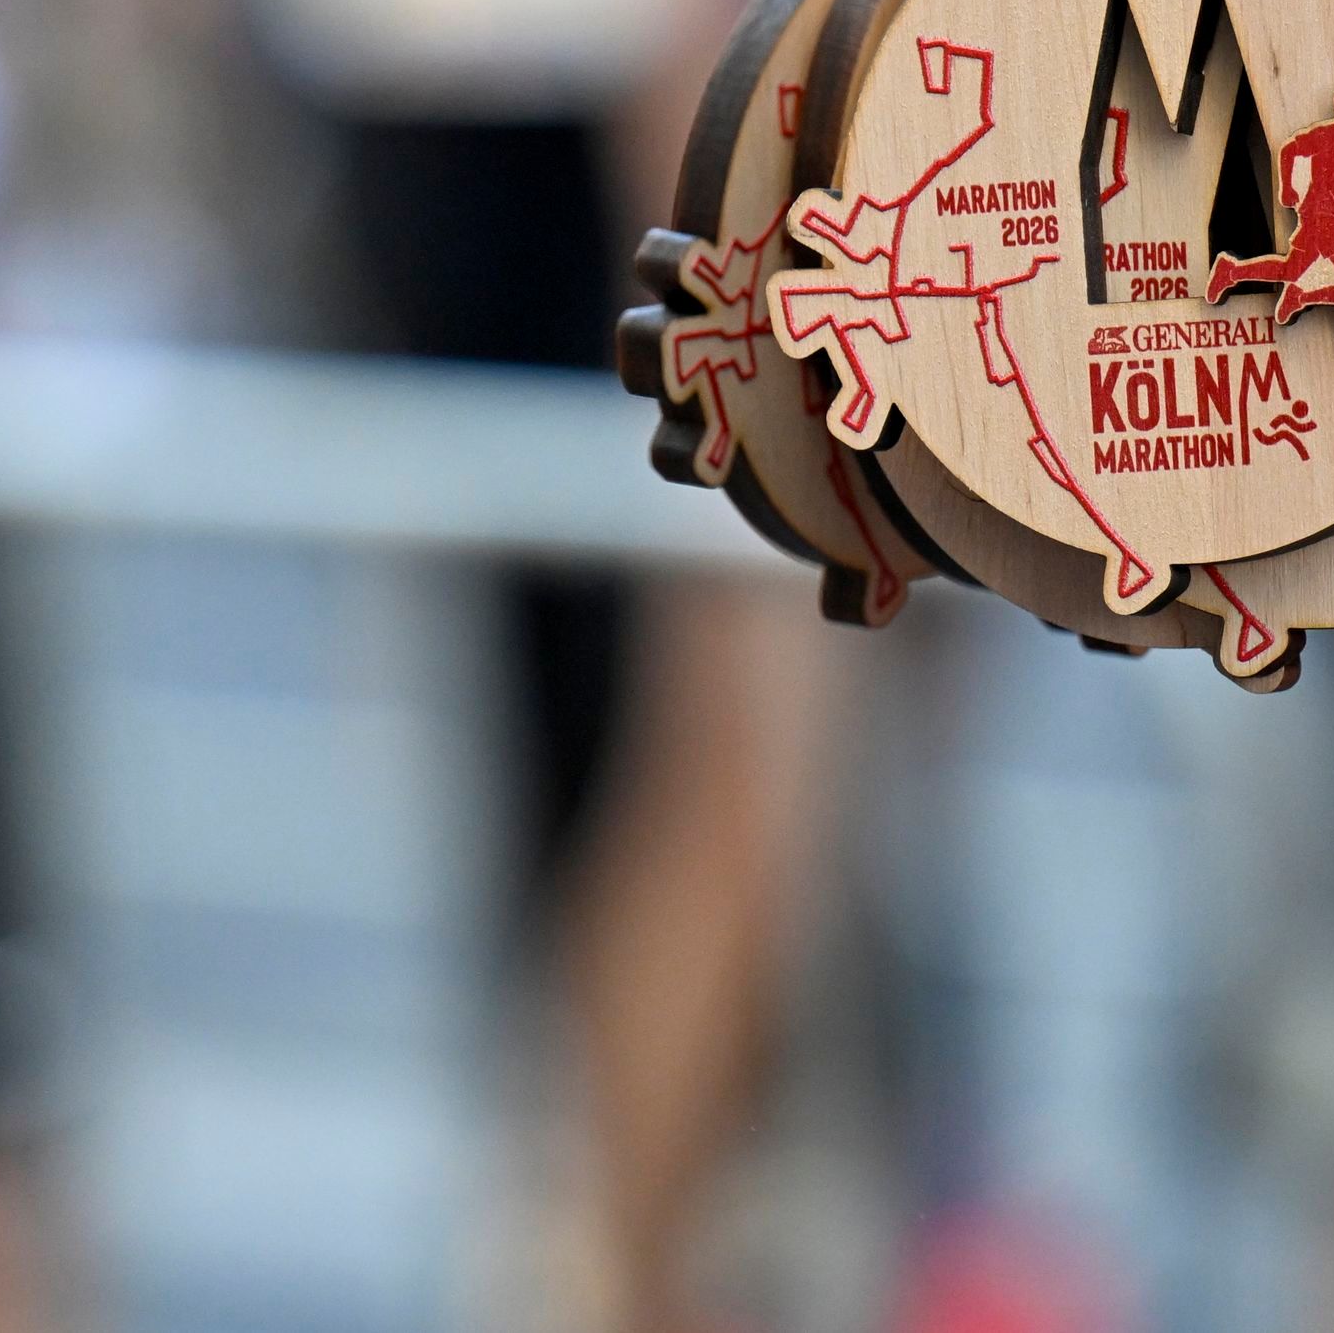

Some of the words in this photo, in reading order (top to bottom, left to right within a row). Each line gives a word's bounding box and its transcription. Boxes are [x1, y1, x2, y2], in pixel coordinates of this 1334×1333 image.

[936, 179, 1057, 217] MARATHON
[1000, 215, 1060, 248] 2026
[1103, 241, 1188, 272] RATHON
[1130, 277, 1189, 302] 2026
[1132, 316, 1277, 352] GENERALI
[1088, 353, 1234, 435] KÖLN
[1093, 432, 1235, 475] MARATHON
